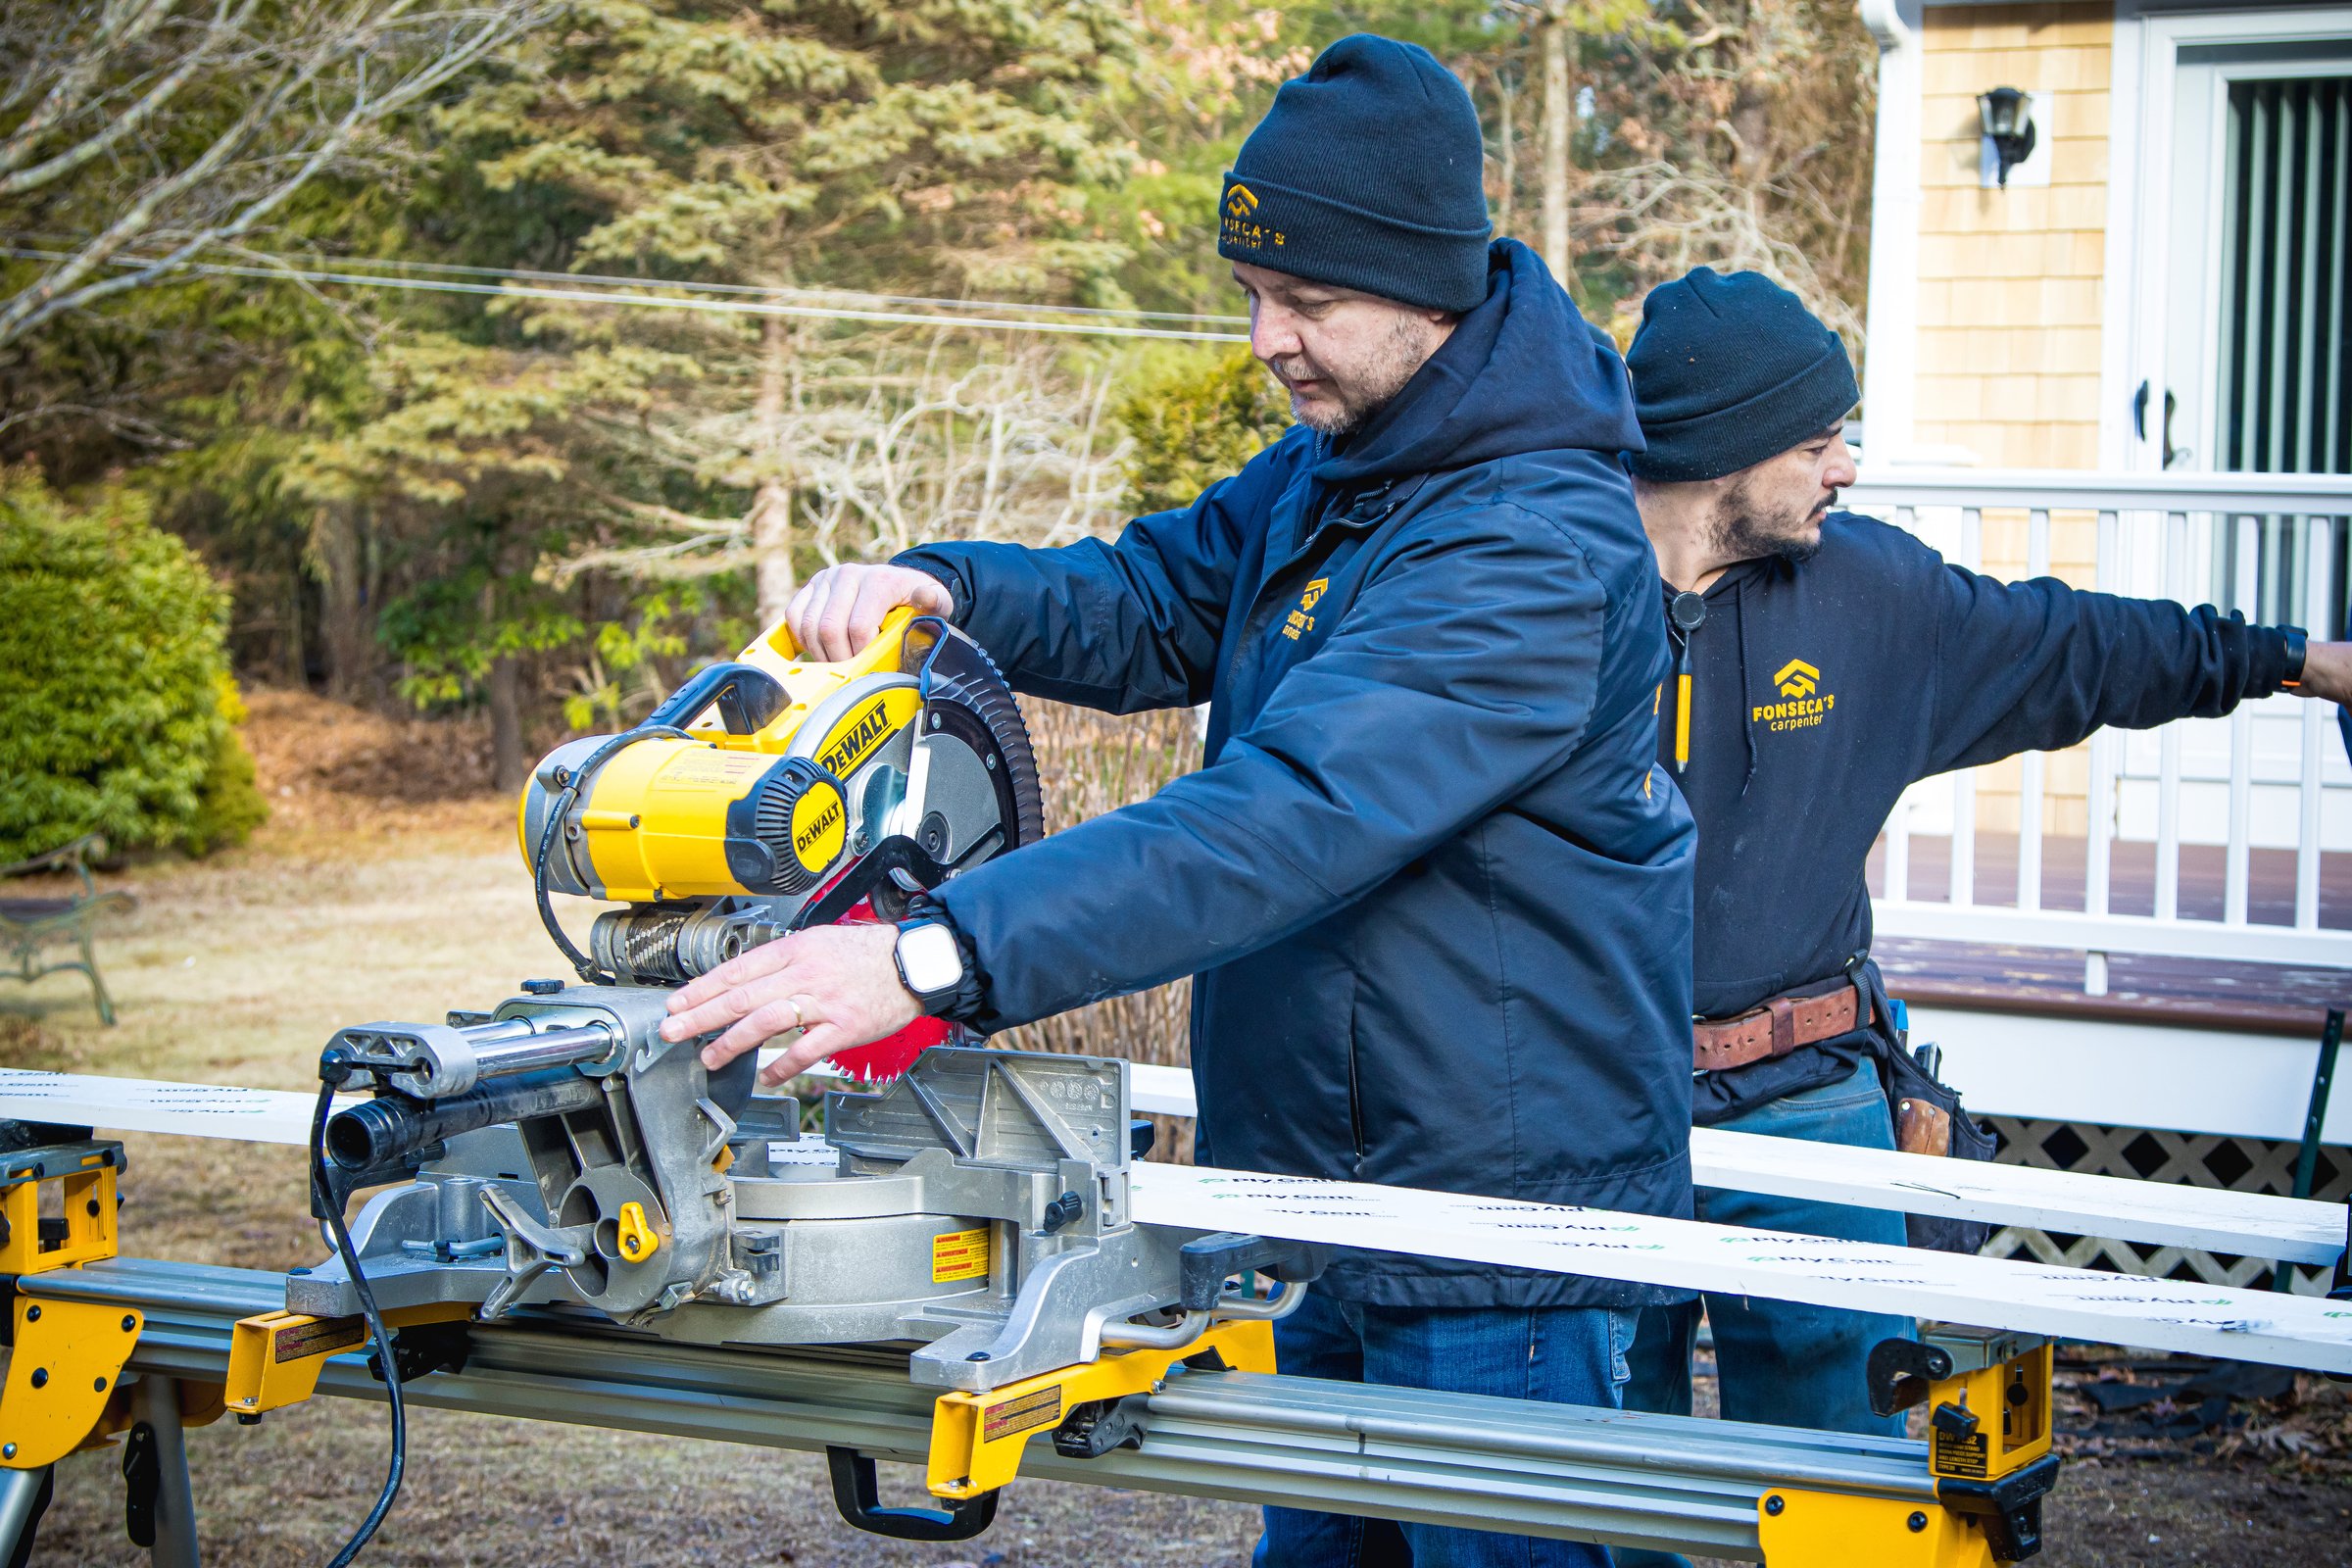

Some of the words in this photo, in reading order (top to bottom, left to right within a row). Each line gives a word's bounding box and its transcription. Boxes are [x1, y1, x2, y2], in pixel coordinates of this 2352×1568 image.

[1752, 694, 1835, 722] FONSECA'S
[1770, 714, 1824, 731] carpenter
[2151, 1296, 2197, 1304] Ply
